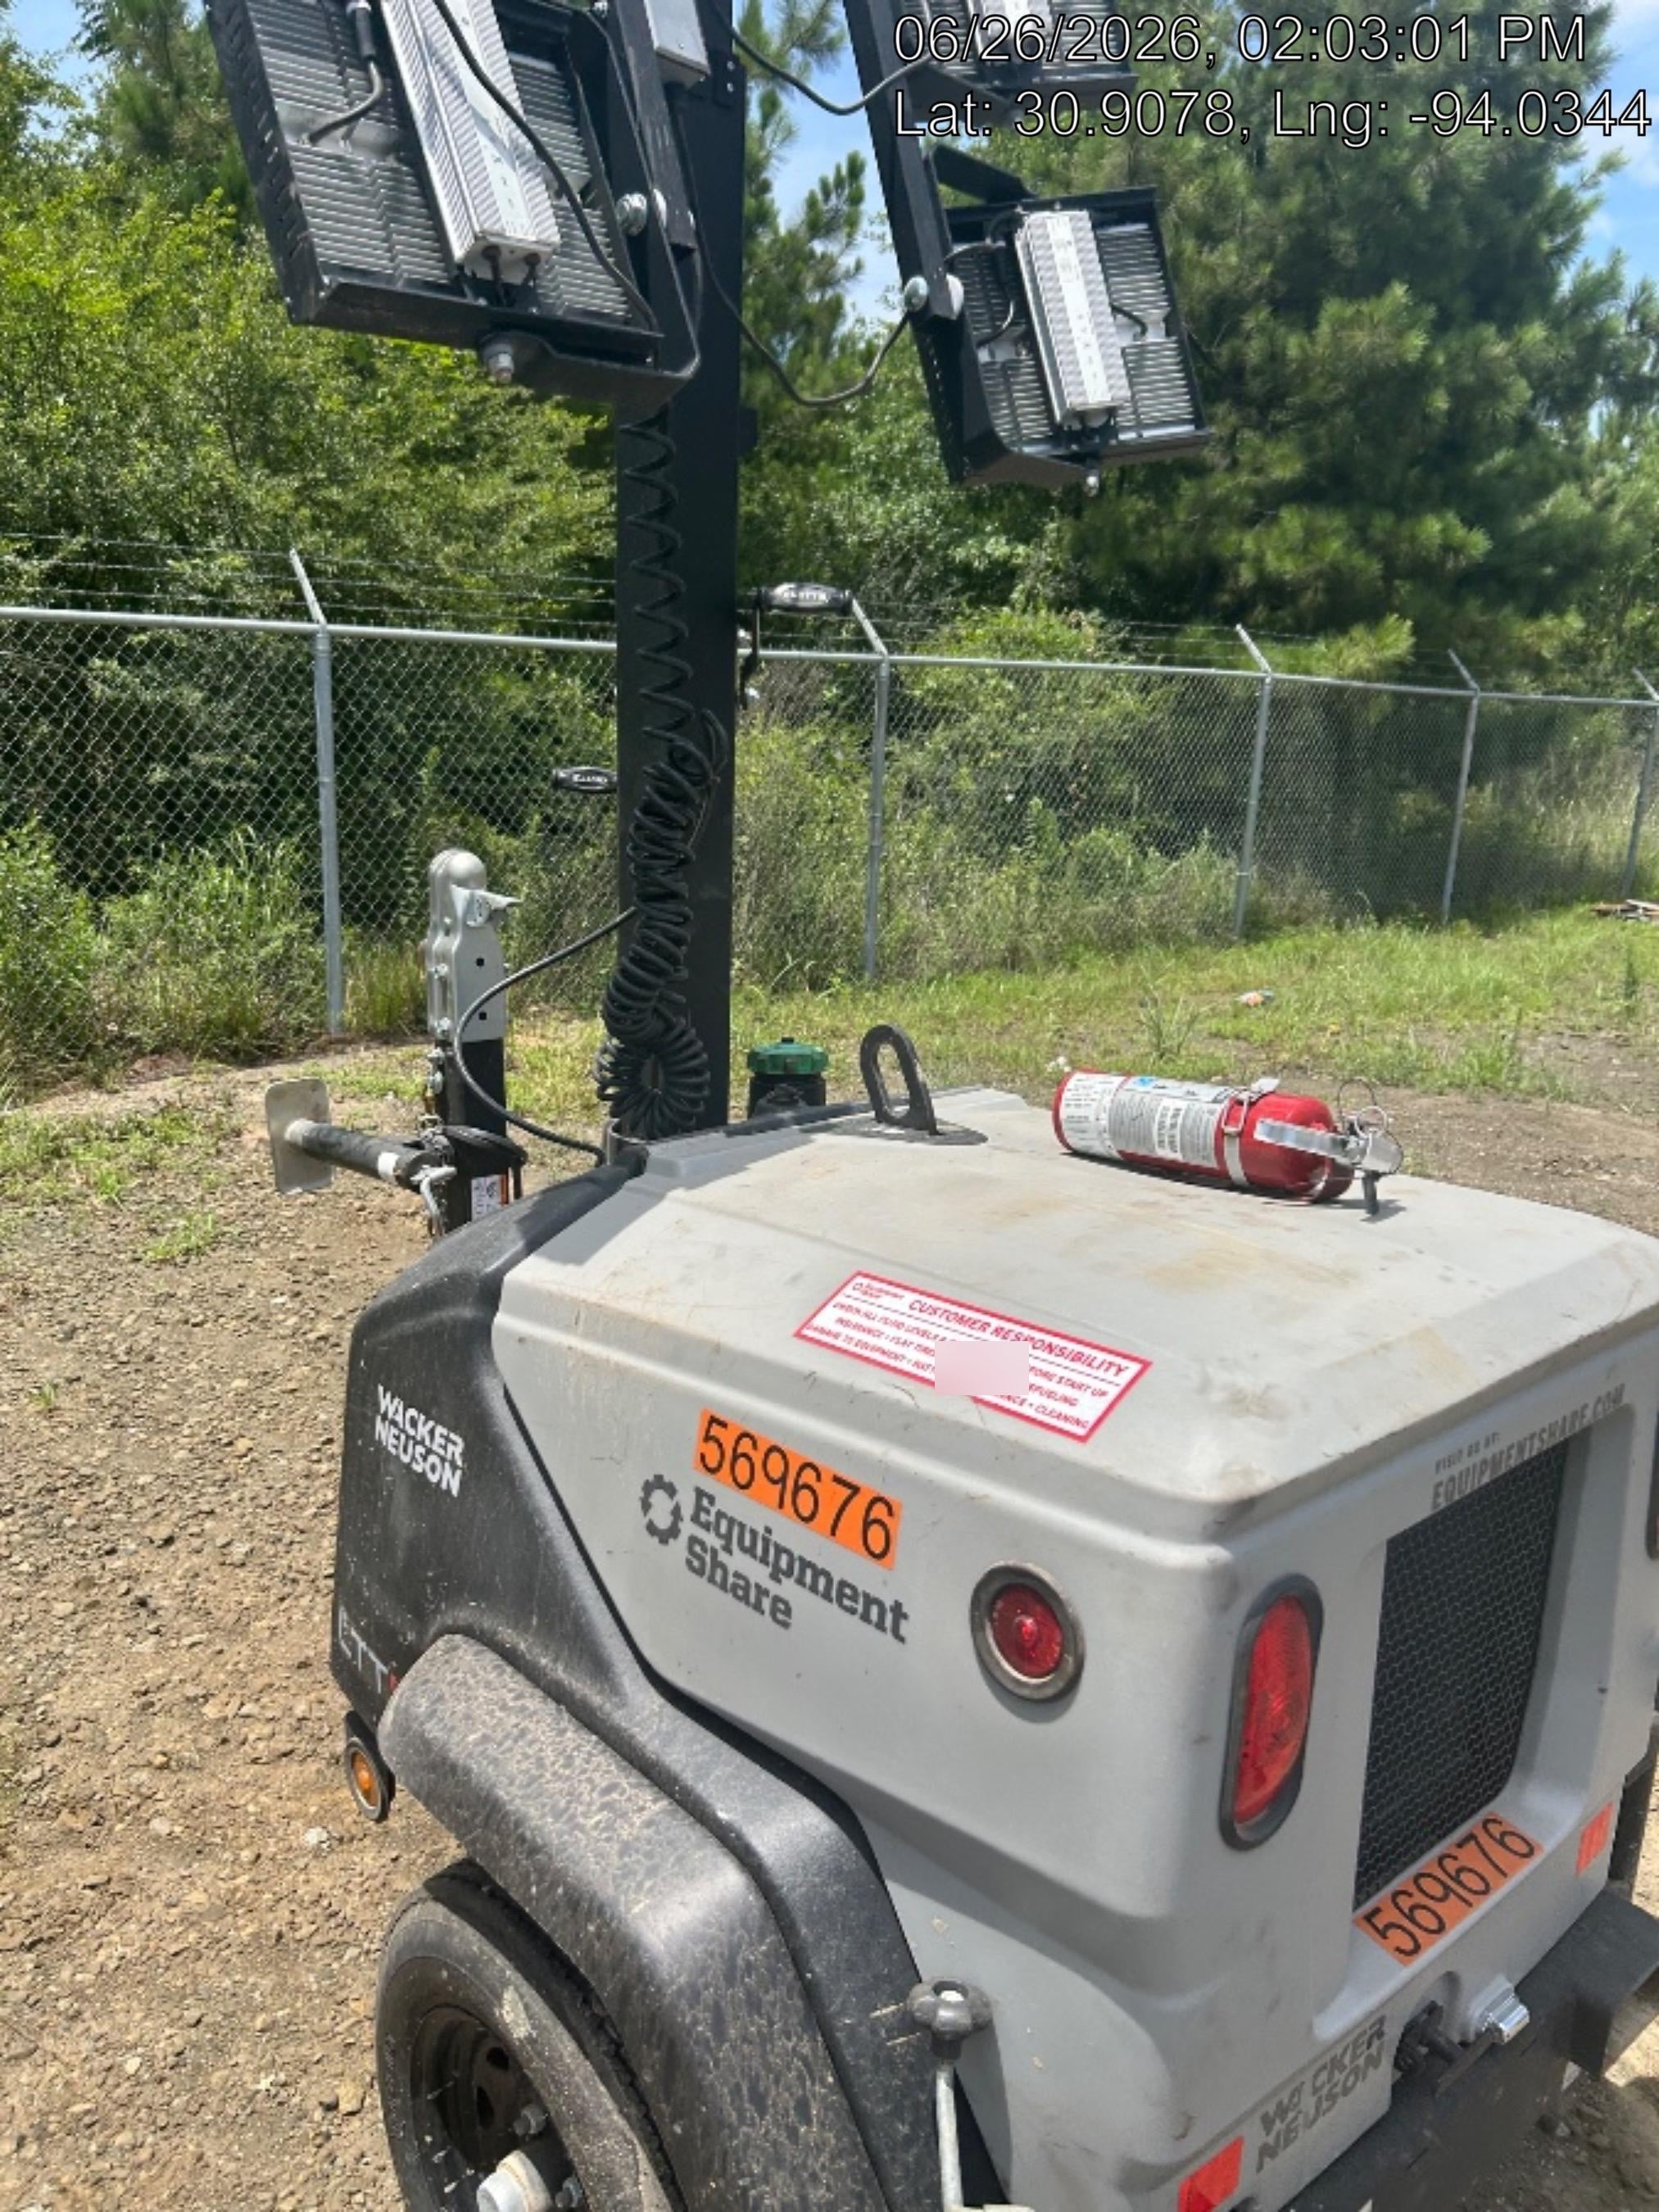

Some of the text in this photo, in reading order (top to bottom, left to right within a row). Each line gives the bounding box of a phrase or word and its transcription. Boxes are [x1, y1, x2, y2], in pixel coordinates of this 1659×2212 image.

[909, 1299, 990, 1332] CUSTOMER
[375, 1414, 463, 1498] NEUSON
[377, 1382, 465, 1468] WACKER
[700, 1415, 894, 1561] 569676
[685, 1534, 792, 1630] Share
[691, 1486, 909, 1644] Equipment
[1363, 1817, 1535, 1957] 569676
[1256, 2041, 1385, 2174] NEUSON
[1260, 2015, 1386, 2137] WACKER
